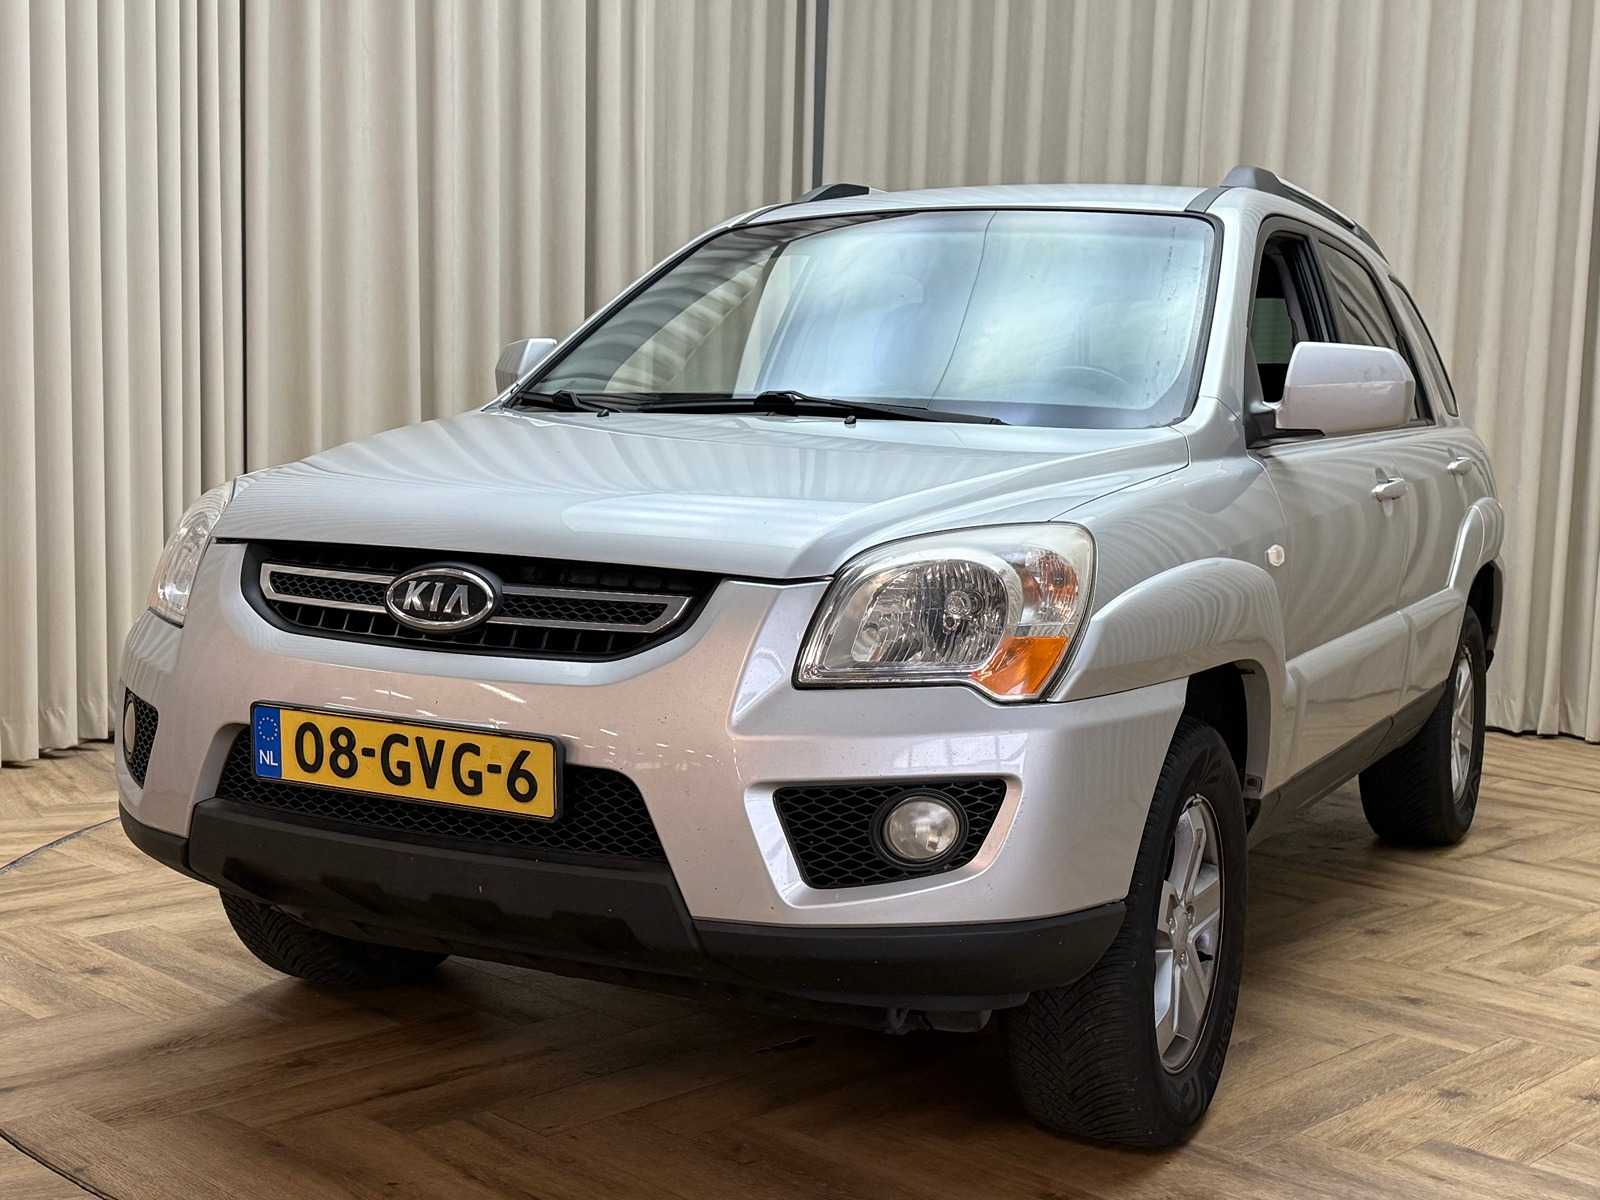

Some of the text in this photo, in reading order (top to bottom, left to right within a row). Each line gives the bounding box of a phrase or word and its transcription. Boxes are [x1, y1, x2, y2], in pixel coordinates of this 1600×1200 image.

[402, 580, 470, 616] KIA
[259, 750, 278, 766] NL
[294, 722, 538, 803] 08-GVG-6
